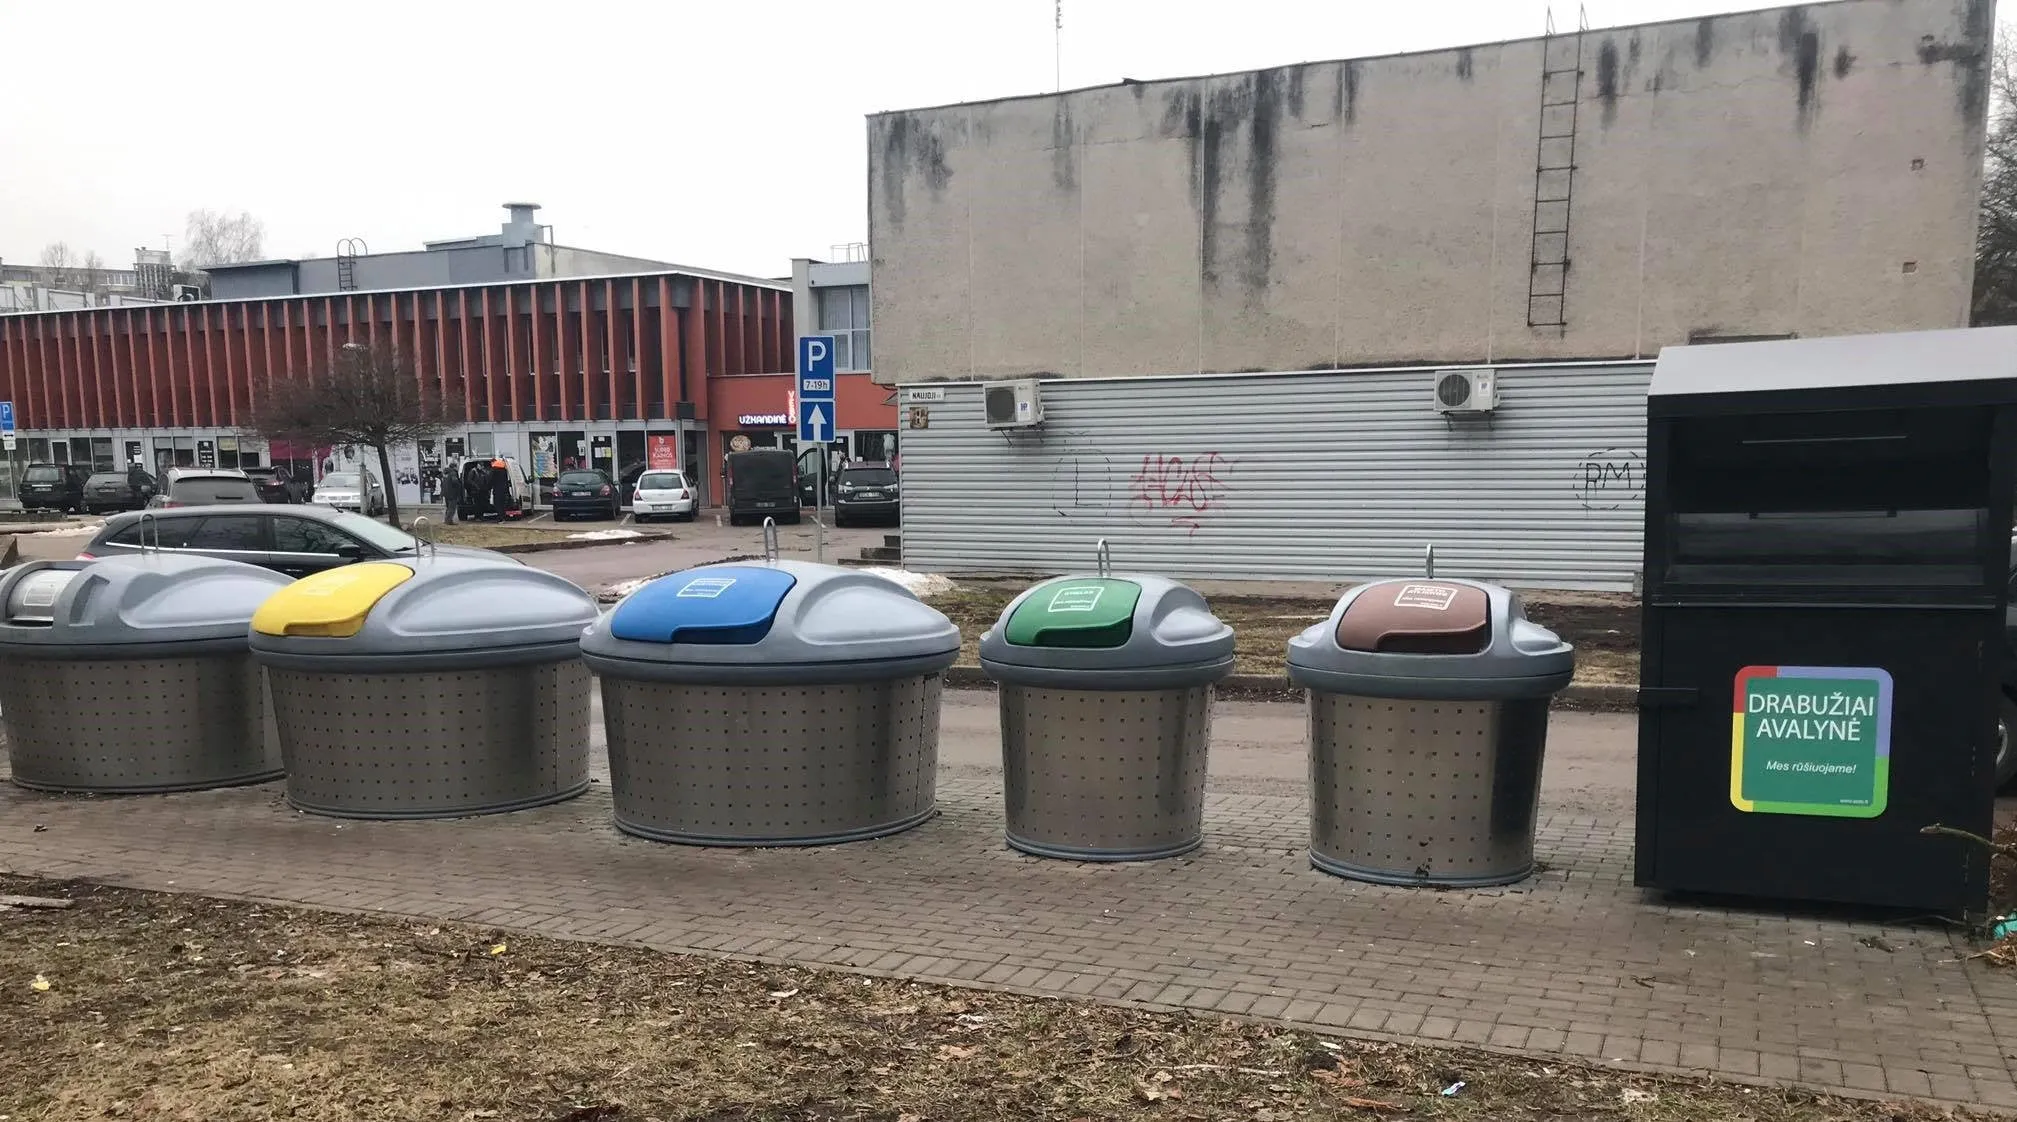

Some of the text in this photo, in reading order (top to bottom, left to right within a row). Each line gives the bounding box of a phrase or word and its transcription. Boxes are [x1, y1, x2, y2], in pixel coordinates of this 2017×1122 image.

[808, 341, 826, 371] P
[805, 380, 828, 390] 7-19h
[912, 392, 937, 400] NAUJOJI
[1749, 691, 1874, 716] DRABUŽIAI
[1756, 717, 1861, 741] AVALYNĖ
[1766, 761, 1857, 775] Mes rūšiuojame!
